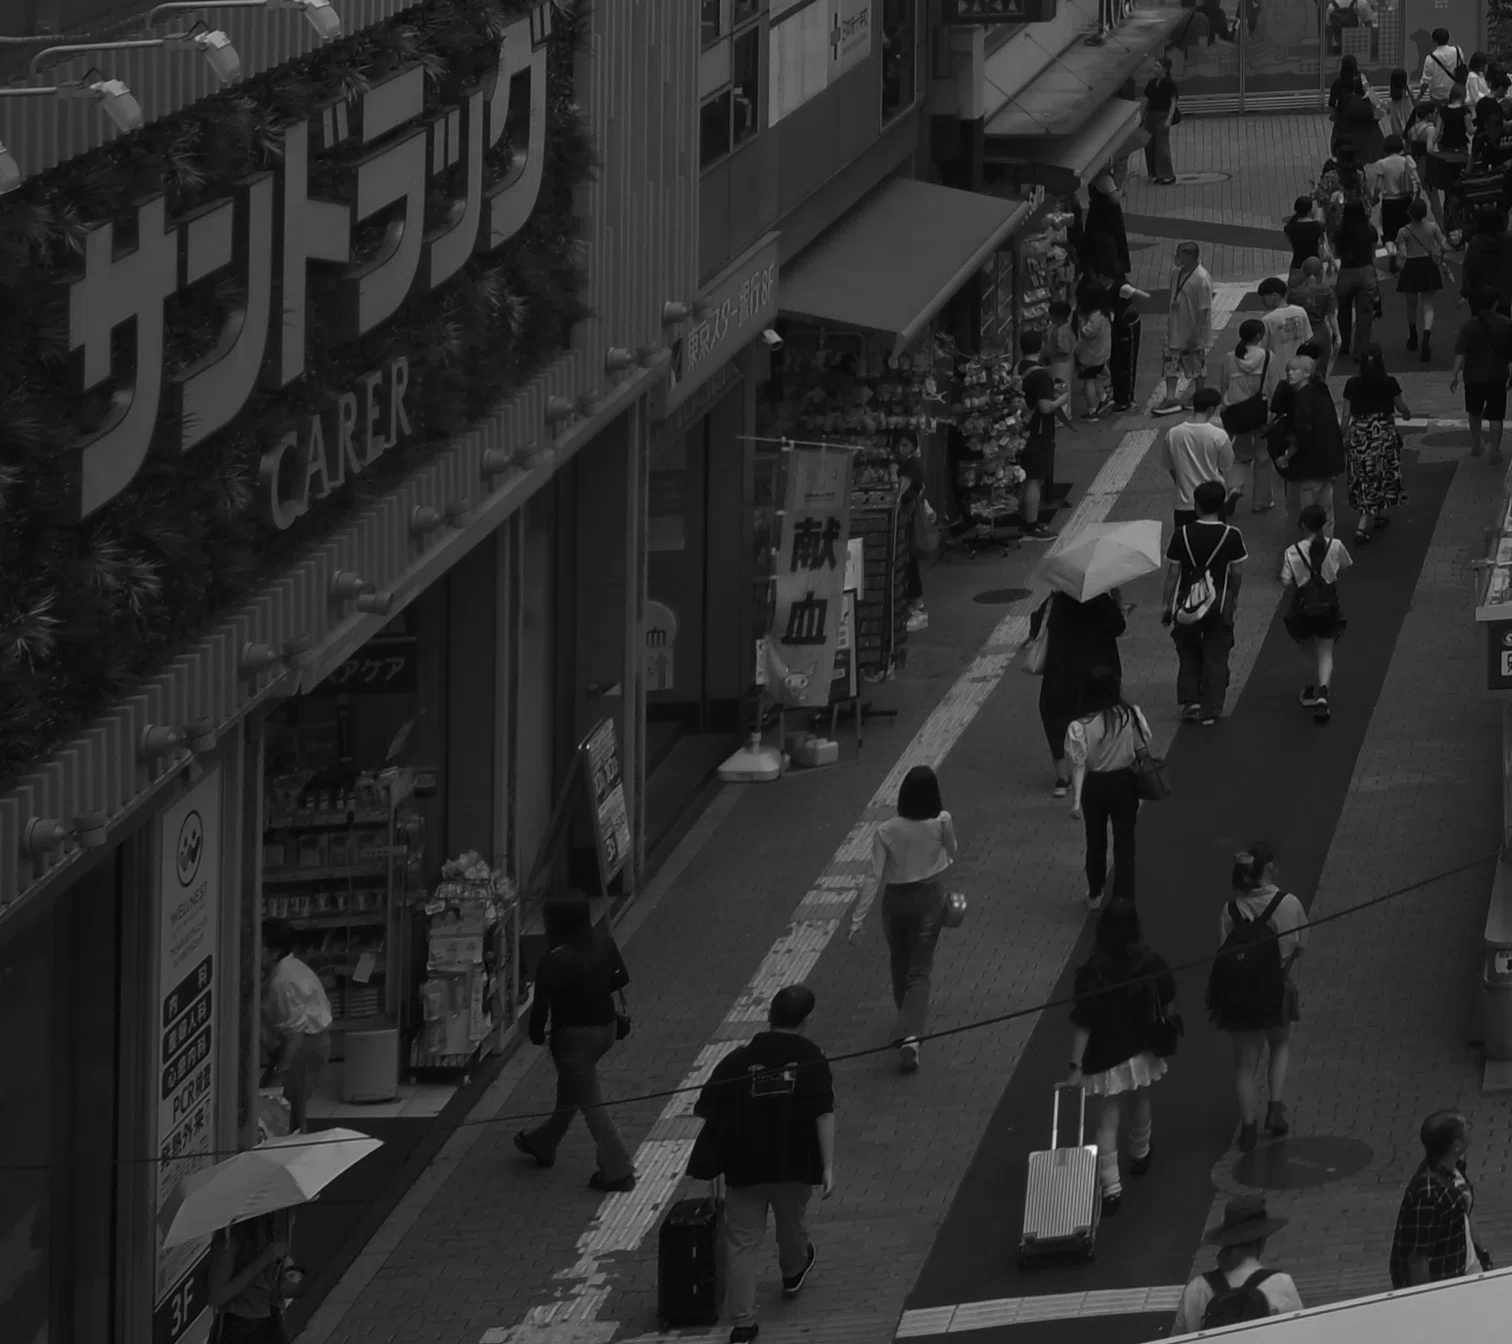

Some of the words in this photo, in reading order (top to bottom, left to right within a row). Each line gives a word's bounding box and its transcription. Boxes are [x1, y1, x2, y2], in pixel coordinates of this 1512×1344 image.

[69, 1, 553, 519] サンドラッグ
[789, 516, 841, 645] 献血
[169, 1282, 195, 1339] 3F
